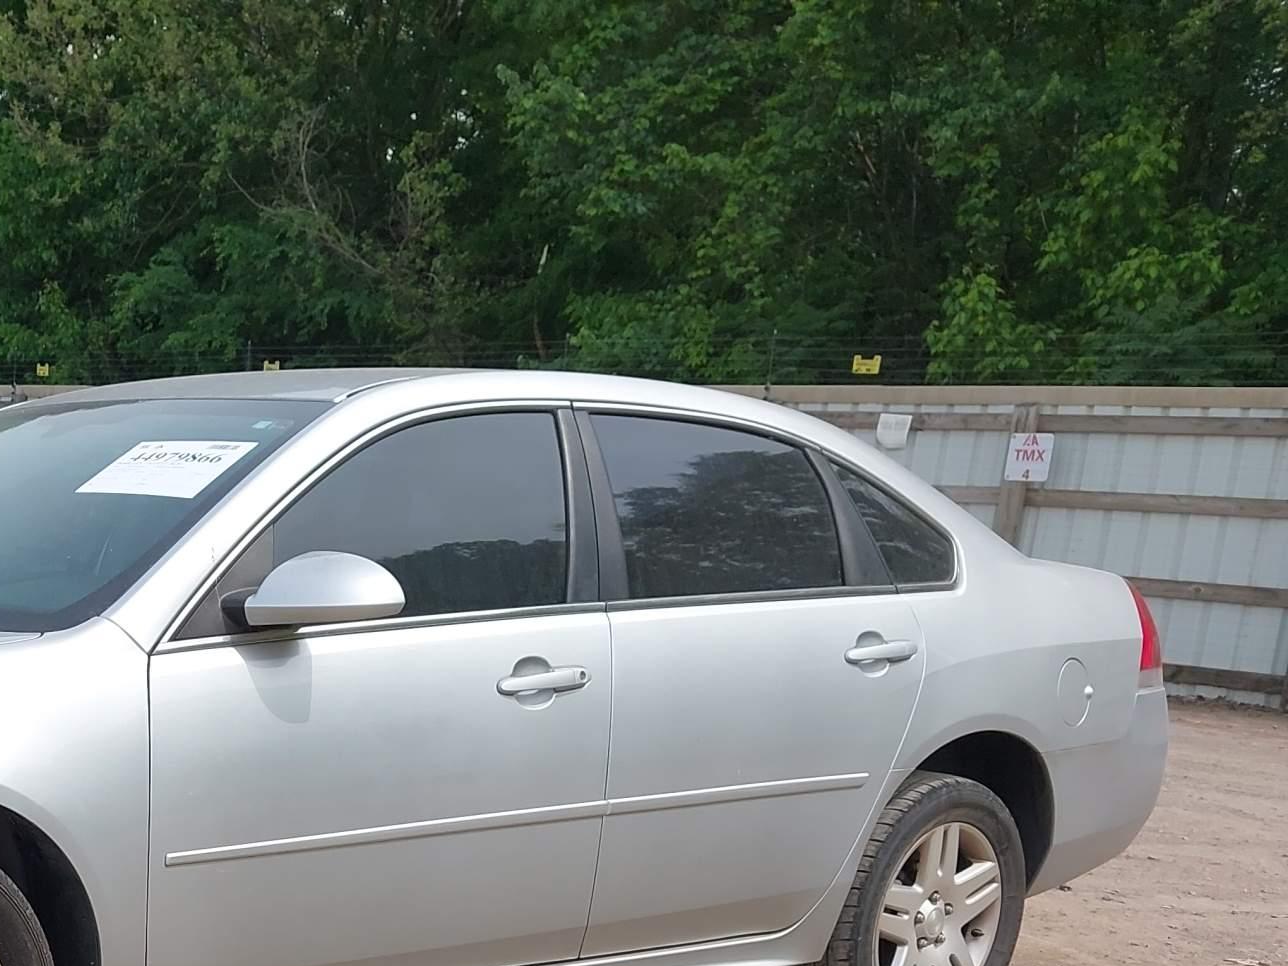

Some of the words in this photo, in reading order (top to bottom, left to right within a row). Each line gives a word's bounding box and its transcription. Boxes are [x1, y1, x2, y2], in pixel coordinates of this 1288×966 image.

[129, 451, 225, 463] 44979866
[1015, 449, 1046, 461] TMX
[1022, 469, 1030, 480] 4
